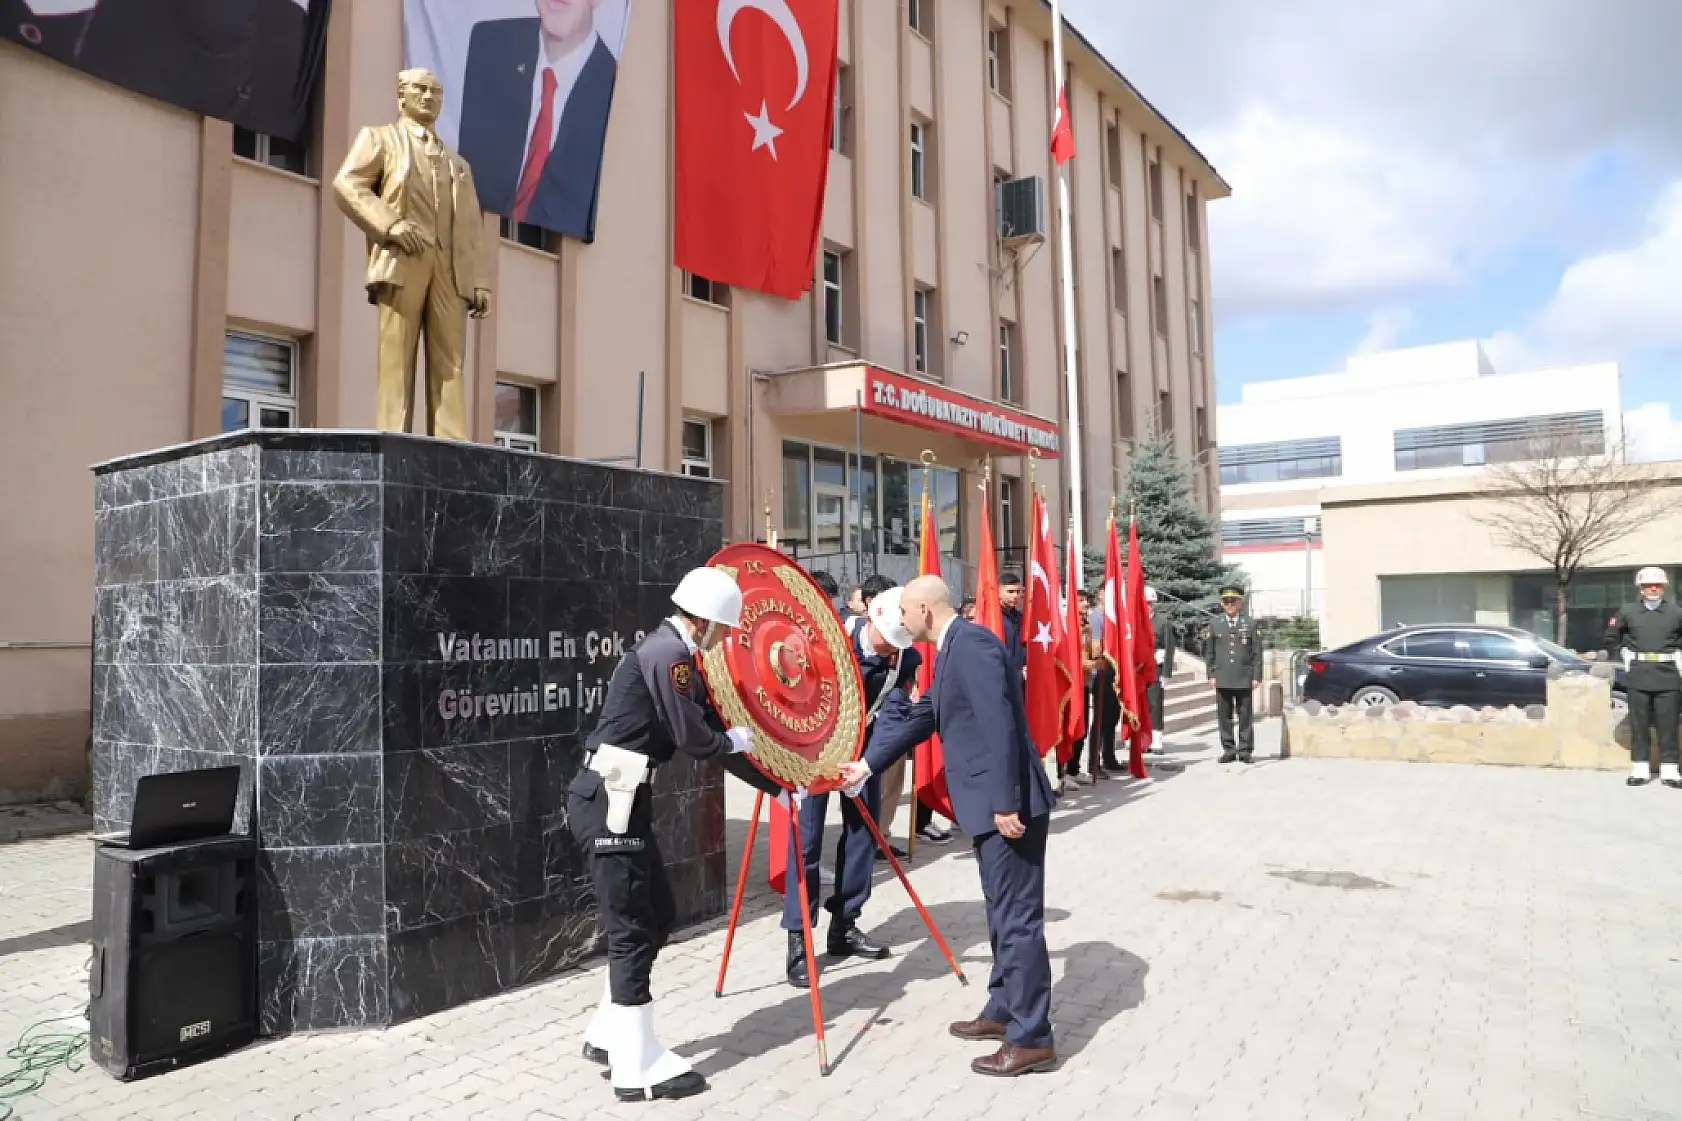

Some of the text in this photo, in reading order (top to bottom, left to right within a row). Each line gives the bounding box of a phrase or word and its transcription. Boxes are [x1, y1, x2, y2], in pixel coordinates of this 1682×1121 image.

[872, 380, 899, 408] T.C.
[437, 630, 625, 664] Vatanını En Çok
[438, 672, 602, 720] Görevini En İyi
